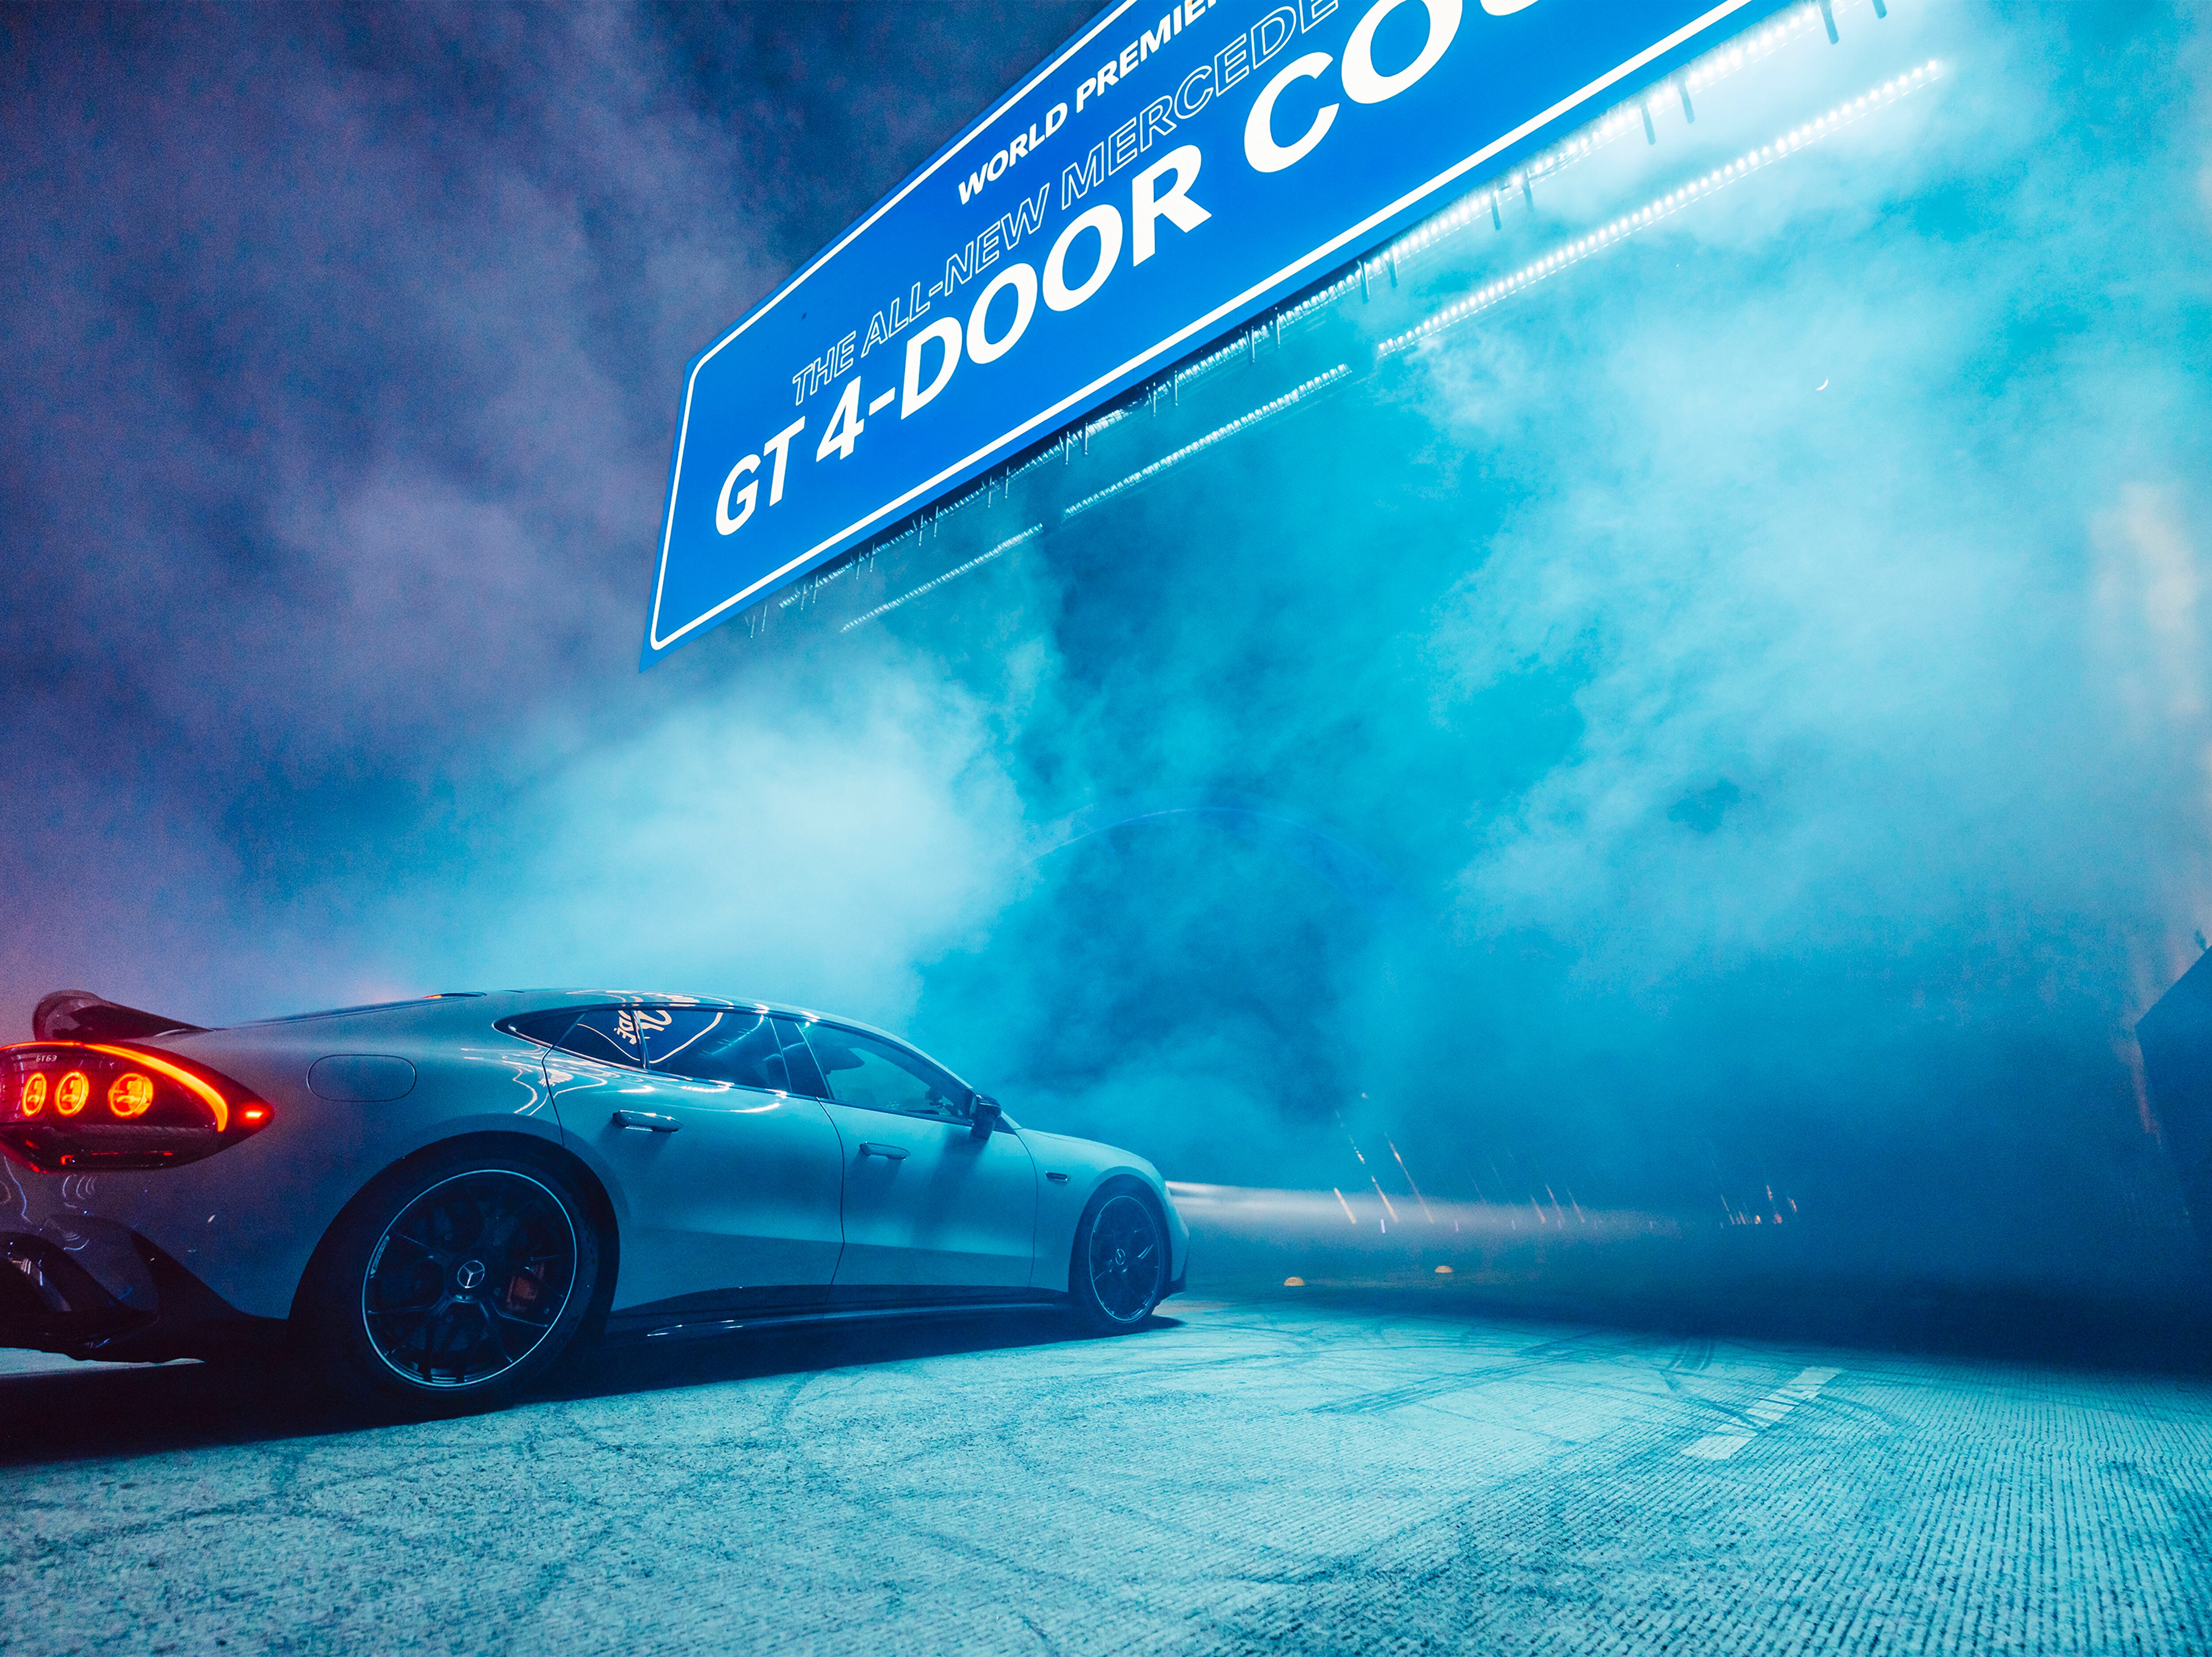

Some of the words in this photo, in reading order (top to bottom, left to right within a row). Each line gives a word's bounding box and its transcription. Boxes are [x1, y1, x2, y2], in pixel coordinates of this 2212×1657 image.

[958, 102, 1068, 205] WORLD
[1076, 0, 1217, 113] PREMIE
[715, 416, 806, 535] GT
[816, 145, 1212, 462] 4-DOOR
[1244, 0, 1539, 173] CO
[792, 331, 856, 406] THE
[860, 182, 1050, 358] ALL-NEW
